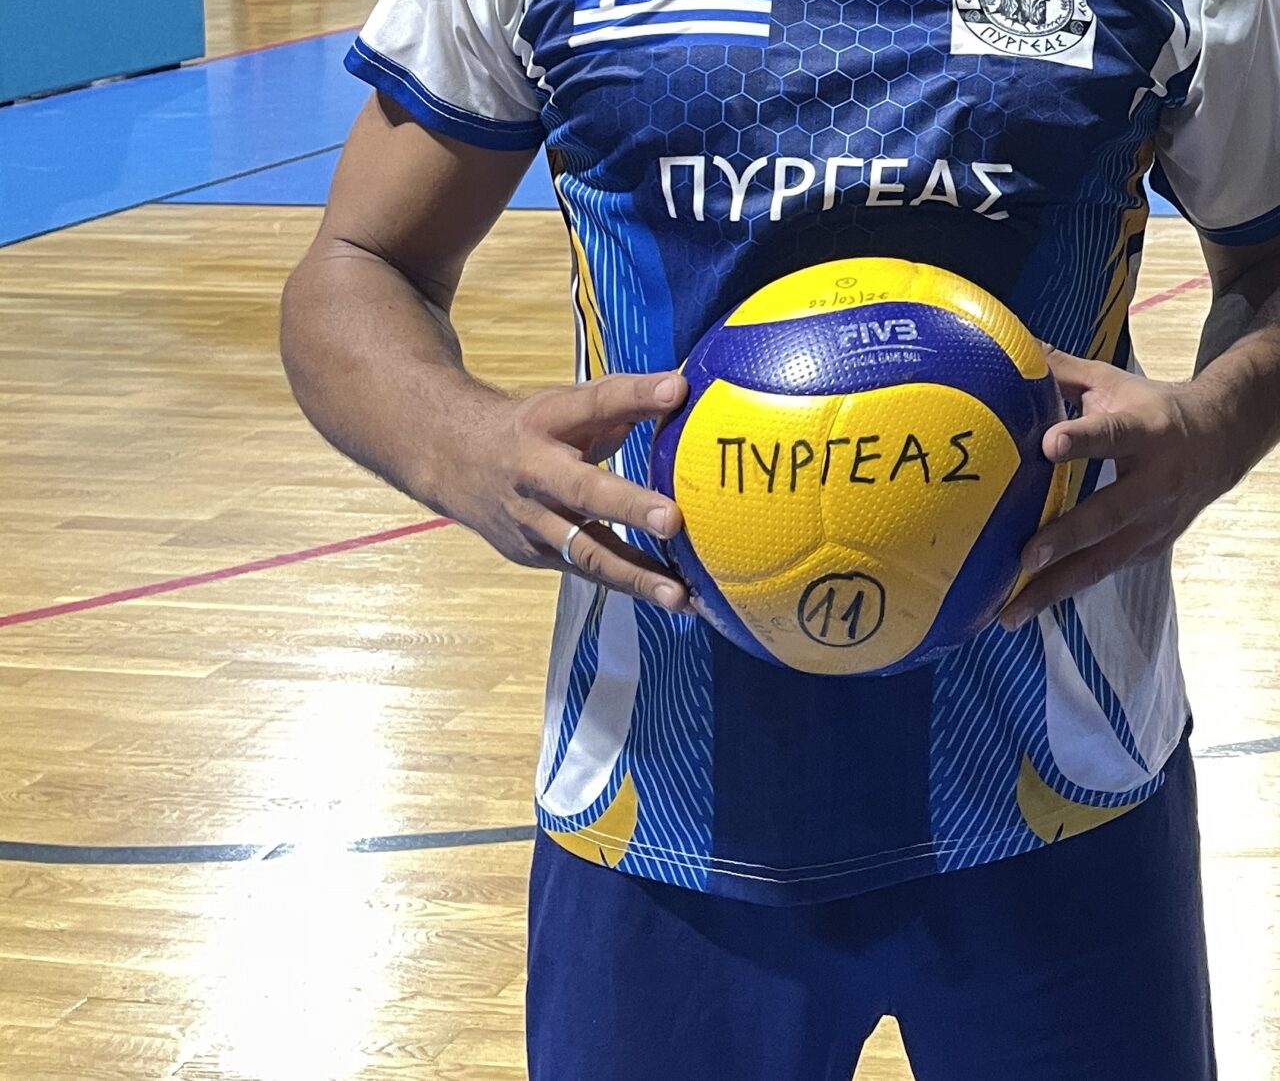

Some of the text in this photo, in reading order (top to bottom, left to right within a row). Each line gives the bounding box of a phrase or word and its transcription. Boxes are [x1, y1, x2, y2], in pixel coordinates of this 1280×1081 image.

[980, 26, 1067, 53] ΠΥΡΓΕΑΣ
[658, 156, 1014, 221] ΠΥΡΓΕΑΣ
[838, 319, 919, 348] FIVB
[717, 430, 981, 494] ΠΥΡΓΕΑΣ
[805, 586, 865, 640] 11
